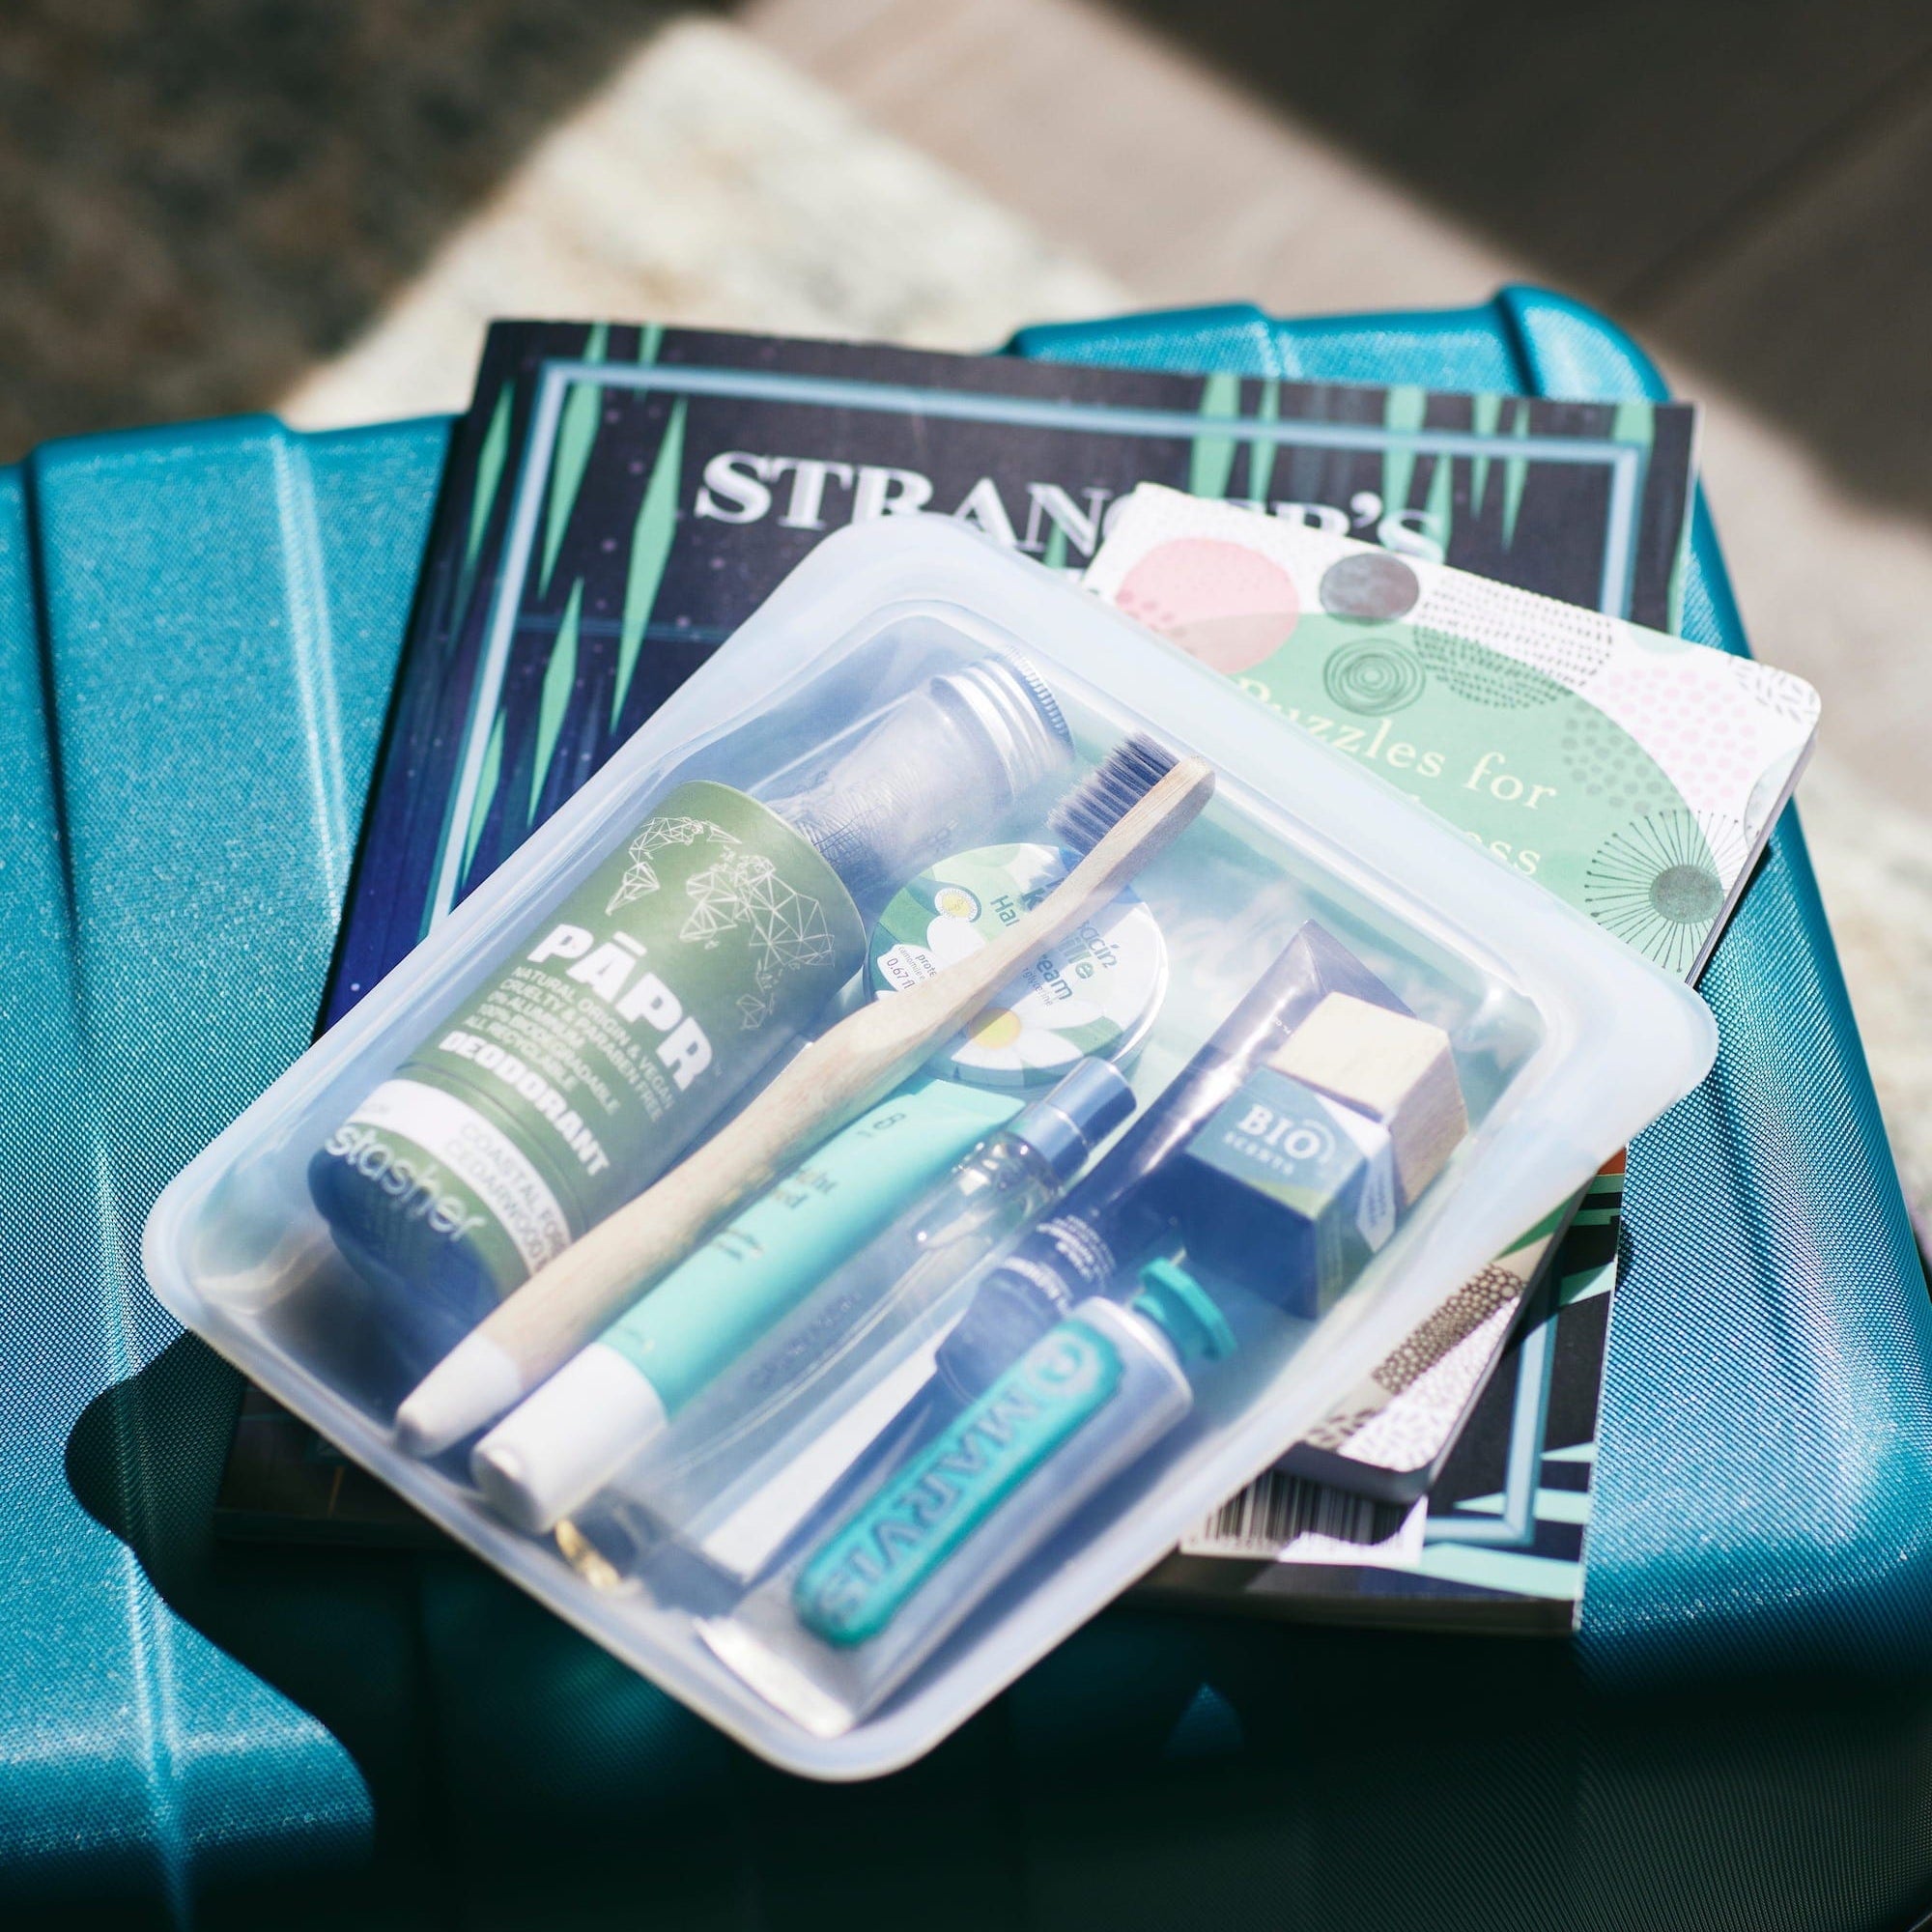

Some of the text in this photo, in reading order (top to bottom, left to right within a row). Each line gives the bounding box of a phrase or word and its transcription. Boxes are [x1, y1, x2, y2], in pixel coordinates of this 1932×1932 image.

[695, 451, 1446, 566] STRAN'S
[1238, 676, 1558, 810] Pzzles for
[887, 957, 909, 979] 0.67
[438, 1030, 610, 1177] DEODORANT
[499, 978, 565, 1012] CRUELTY
[574, 1016, 639, 1084] PARABEN
[634, 1080, 664, 1122] FREE
[511, 966, 577, 1003] NATURAL
[578, 997, 631, 1047] ORIGIN
[638, 1056, 675, 1111] VEGAN
[324, 1125, 487, 1242] stasher
[1236, 1103, 1321, 1159] BIO
[817, 1386, 1039, 1625] MARVIS
